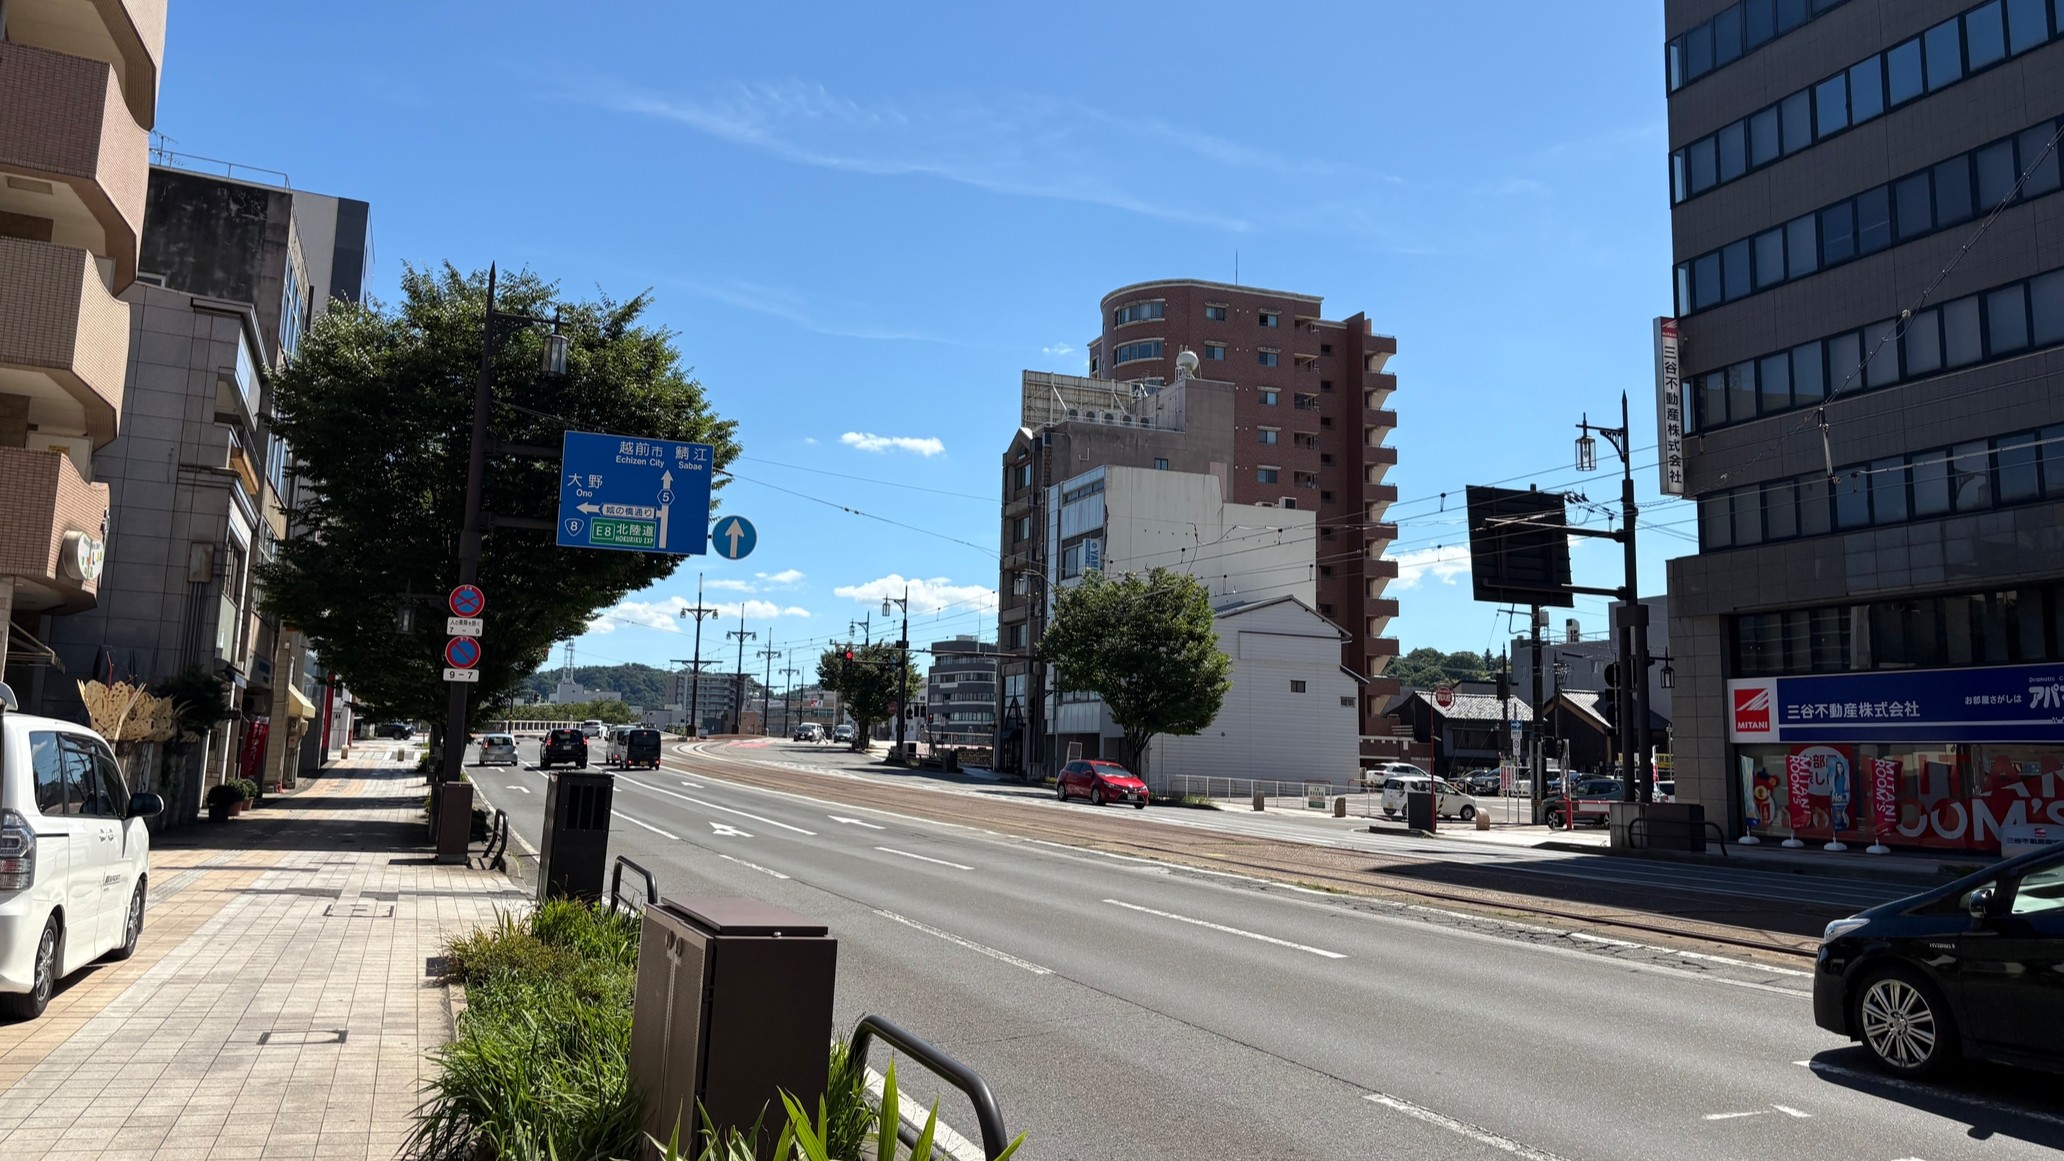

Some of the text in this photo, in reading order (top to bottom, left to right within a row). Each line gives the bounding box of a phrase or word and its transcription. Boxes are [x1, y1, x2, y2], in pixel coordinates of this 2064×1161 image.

[1664, 346, 1682, 483] 三谷不動産株式会社
[618, 440, 664, 458] 越前市
[675, 445, 708, 462] 鯖江
[616, 456, 665, 469] Echizen City
[678, 461, 703, 471] Sabae
[567, 473, 603, 490] 大野
[576, 489, 593, 498] Ono
[662, 492, 669, 501] 5
[570, 521, 578, 531] 8
[616, 523, 654, 537] 北陸道
[615, 535, 654, 545] HOKURIKU EXP
[1964, 694, 2023, 705] お部屋さがしは
[1787, 700, 1921, 719] 三谷不動産株式会社
[1737, 721, 1768, 729] MITANI
[1789, 755, 1801, 805] ROOM'S
[1799, 756, 1812, 815] MITANI
[1874, 759, 1886, 813] ROOM'S
[1884, 761, 1898, 822] MITANI
